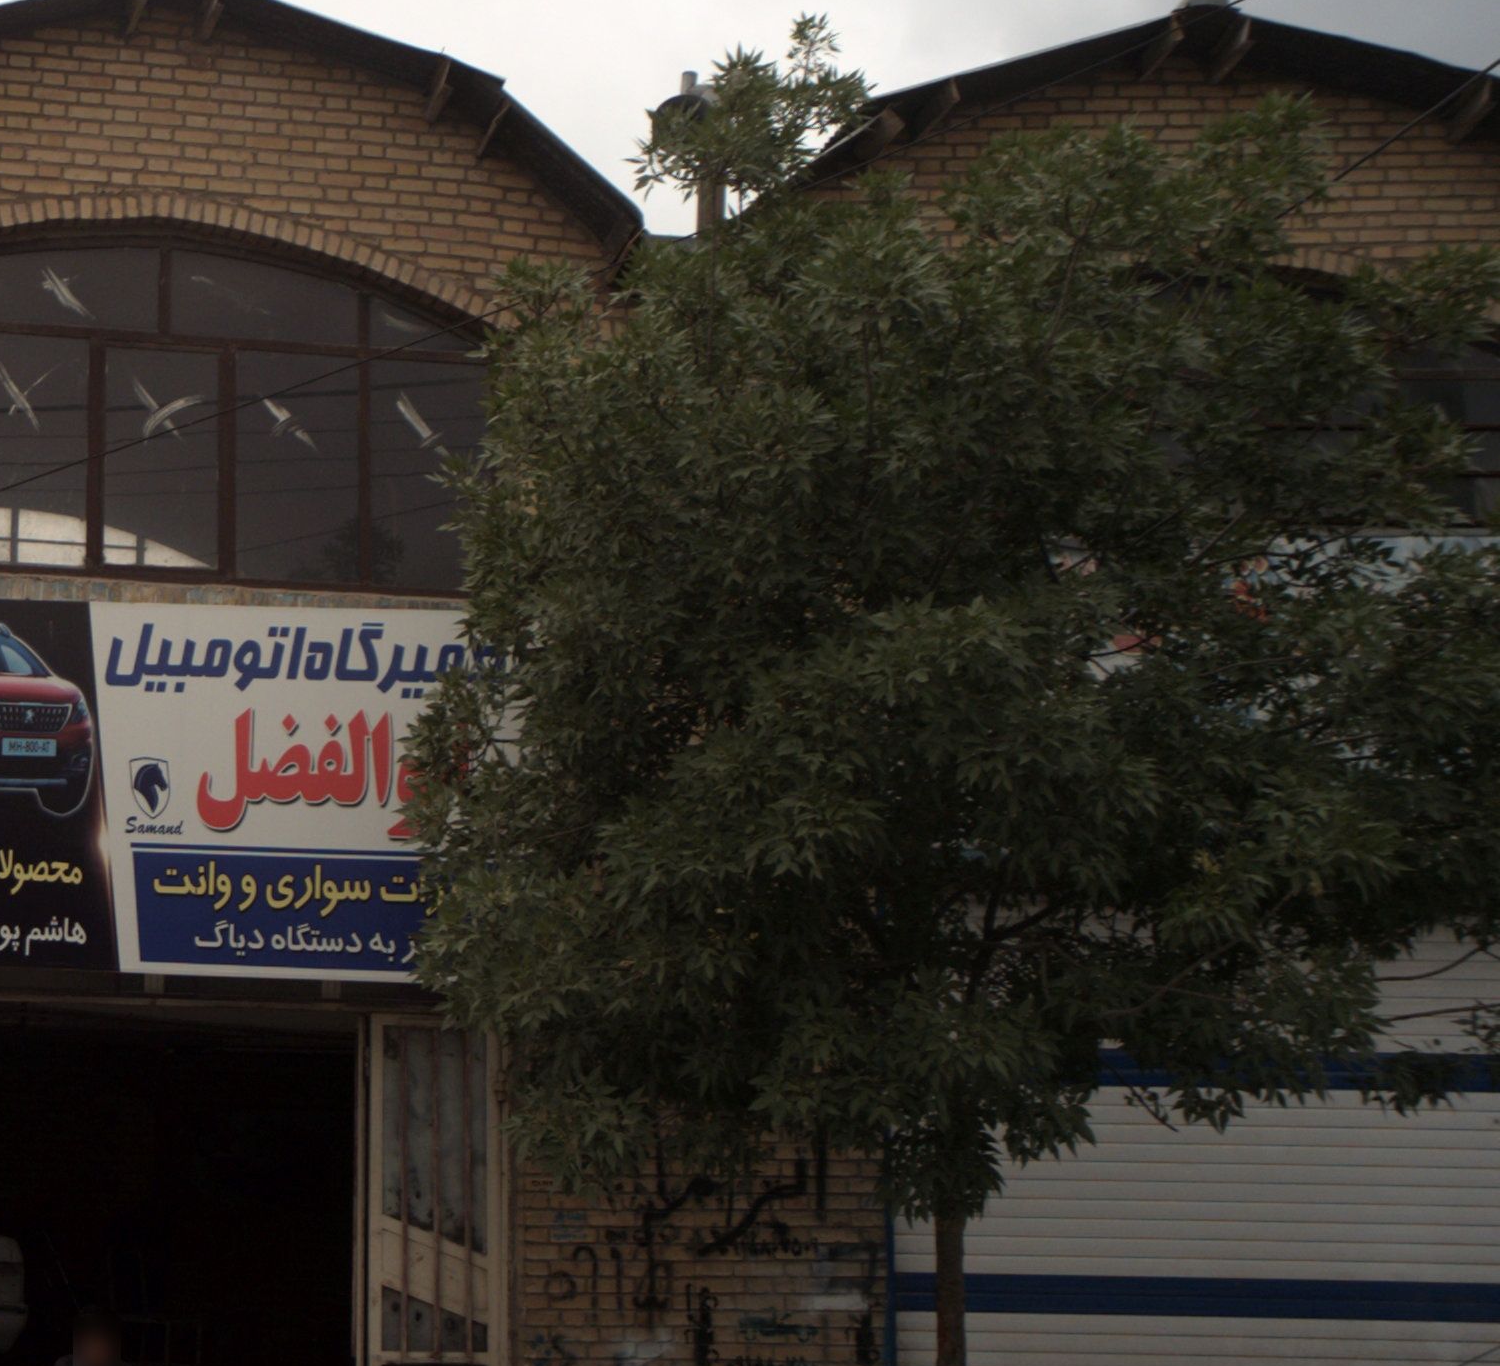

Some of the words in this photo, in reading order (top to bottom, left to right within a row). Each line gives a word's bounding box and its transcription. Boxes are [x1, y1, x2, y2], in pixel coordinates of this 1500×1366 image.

[104, 623, 308, 694] اتومبیل
[304, 622, 513, 699] عمیرگاه
[124, 816, 184, 835] Samand
[153, 860, 233, 913] وانت
[237, 874, 257, 913] و
[265, 864, 372, 918] سواری
[24, 916, 88, 957] هاشم
[193, 920, 265, 957] دیاگ
[270, 923, 364, 955] دستگاه
[368, 931, 397, 963] به
